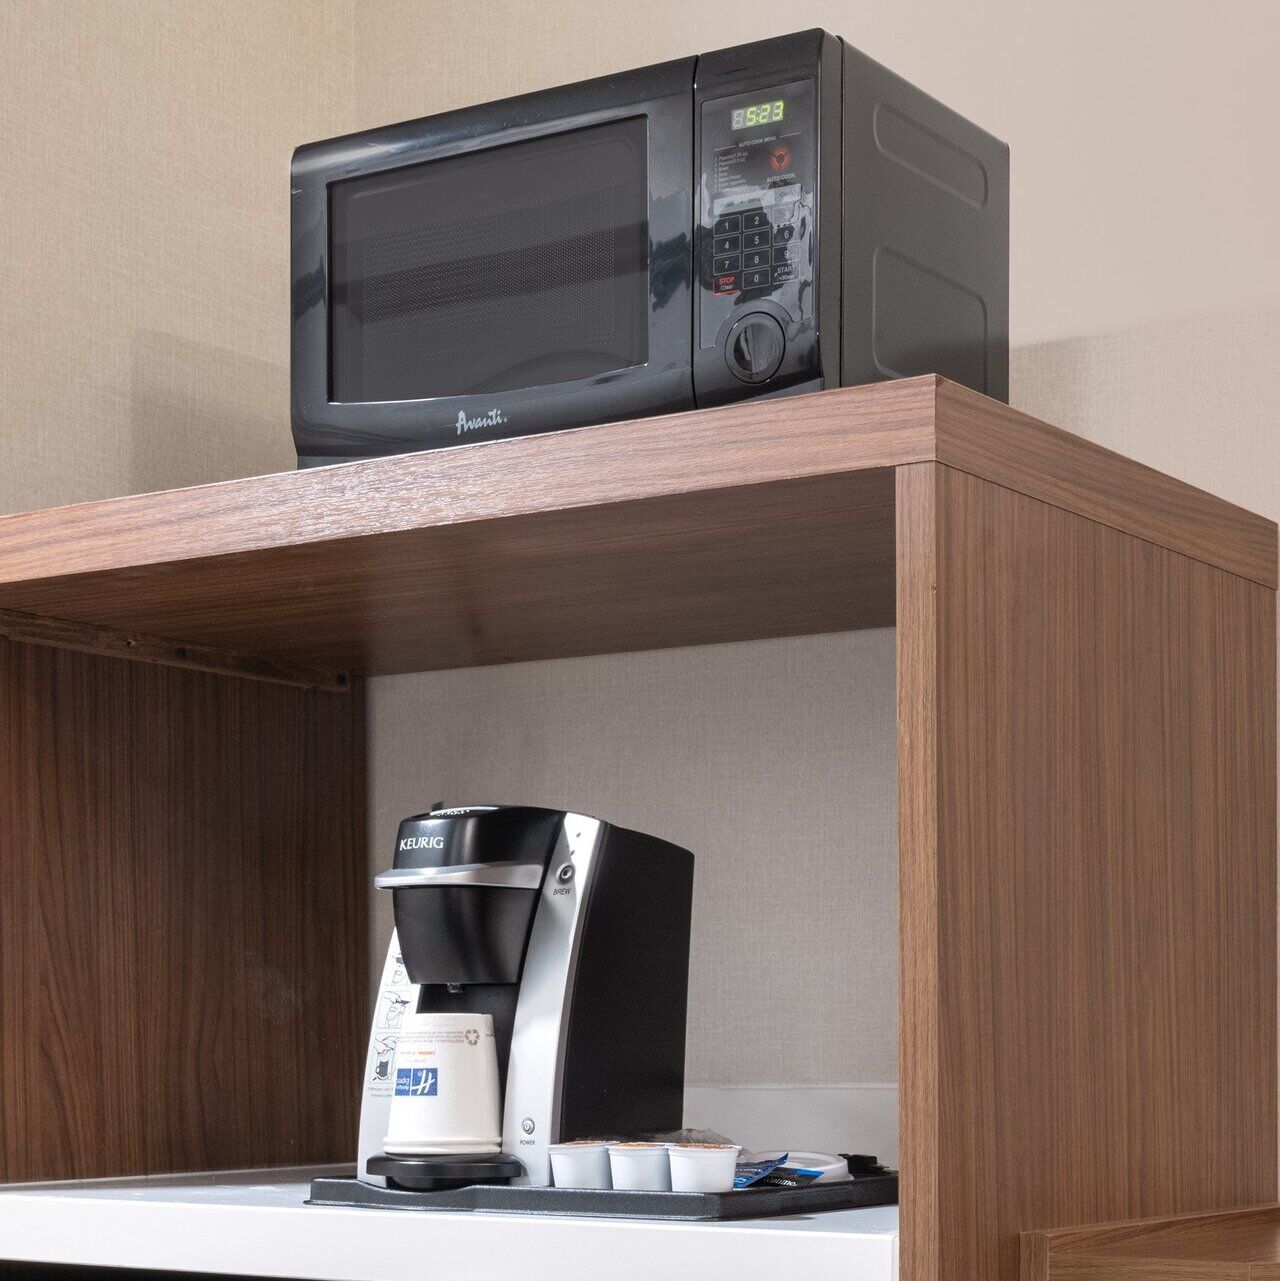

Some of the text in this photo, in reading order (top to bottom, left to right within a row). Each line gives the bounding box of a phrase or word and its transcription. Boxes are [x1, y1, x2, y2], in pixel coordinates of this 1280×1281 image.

[746, 101, 784, 126] 5:23
[777, 265, 795, 274] START
[719, 277, 735, 285] STOP
[456, 409, 502, 435] Avanti
[399, 837, 444, 850] KEURIG
[553, 888, 571, 896] BREW
